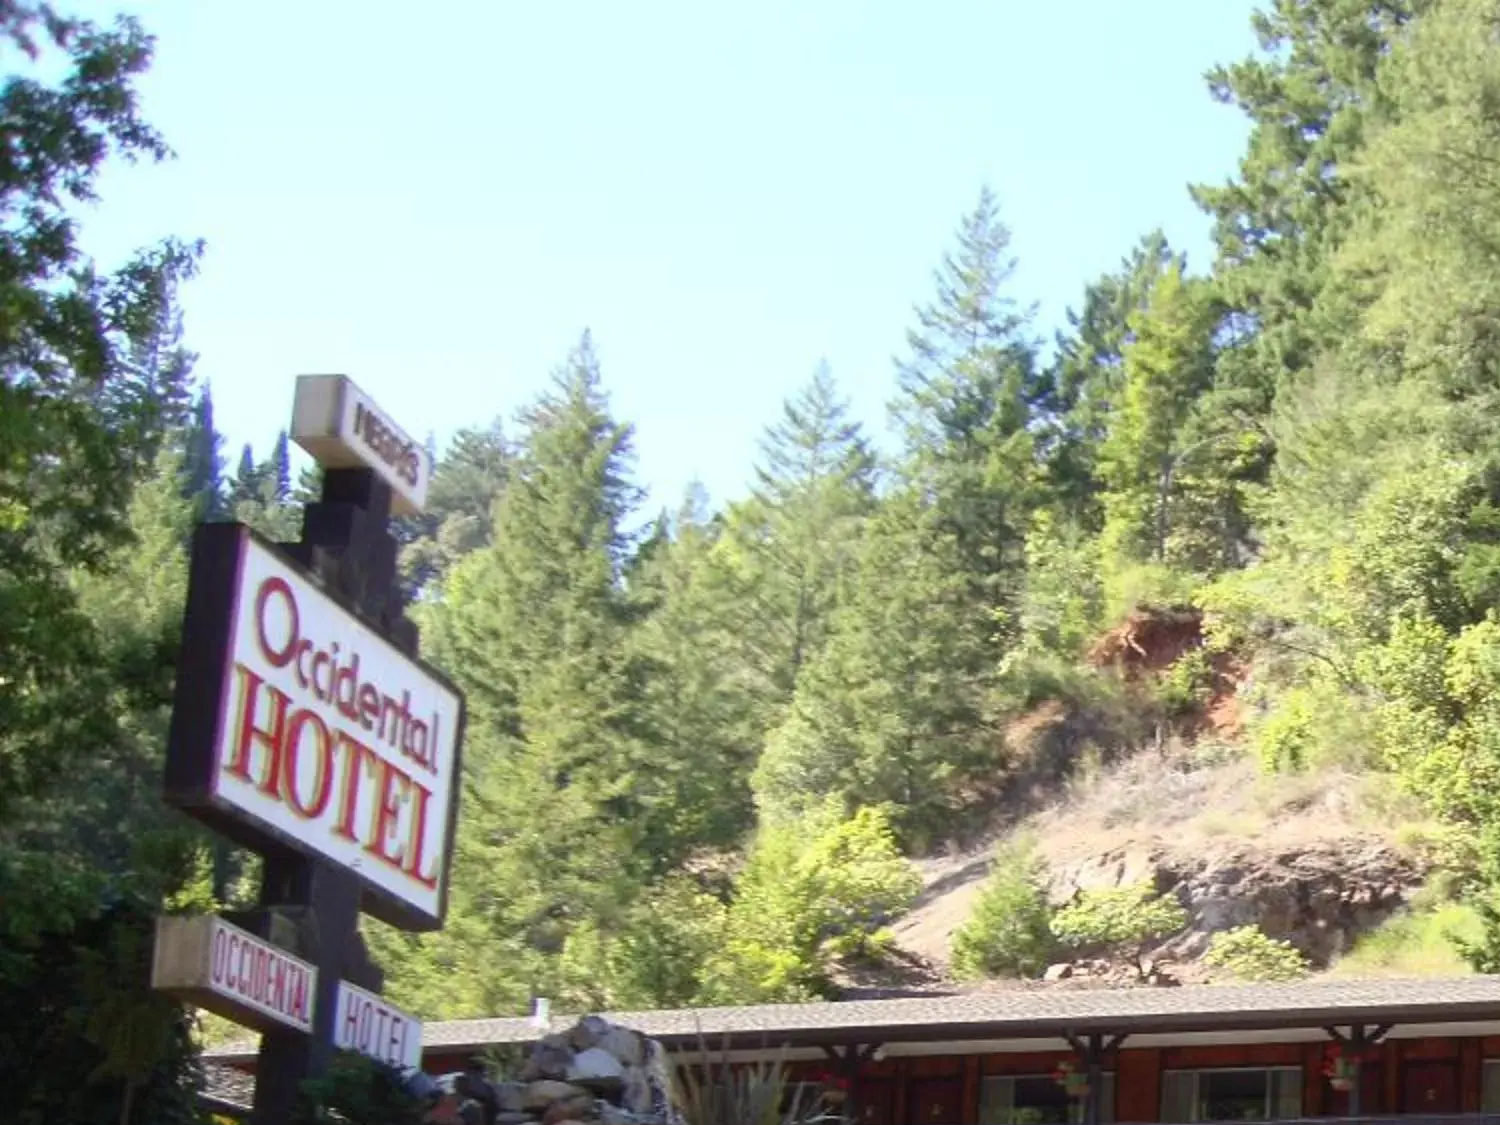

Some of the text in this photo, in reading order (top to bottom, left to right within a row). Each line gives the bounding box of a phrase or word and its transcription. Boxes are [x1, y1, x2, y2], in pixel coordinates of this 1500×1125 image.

[254, 576, 439, 774] Occidental
[223, 661, 437, 889] HOTEL
[343, 990, 411, 1068] HOTEL
